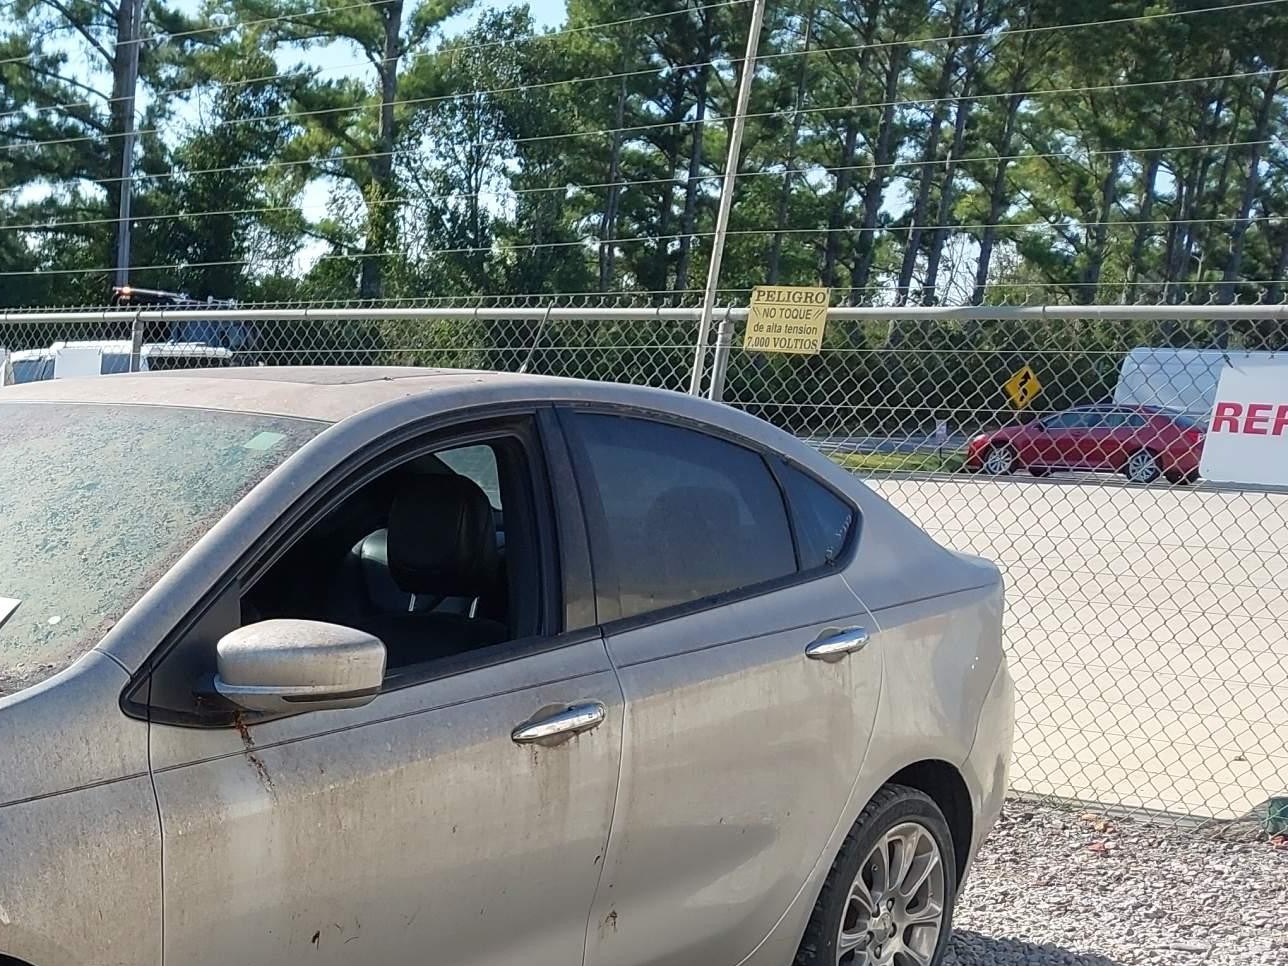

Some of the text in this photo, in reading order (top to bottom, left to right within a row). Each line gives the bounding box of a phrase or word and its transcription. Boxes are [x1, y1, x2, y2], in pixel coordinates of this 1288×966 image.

[755, 290, 826, 304] PELIGRO
[762, 307, 813, 320] NO TOQUE
[753, 322, 818, 336] de alta tension
[772, 337, 818, 349] VOLTIOS
